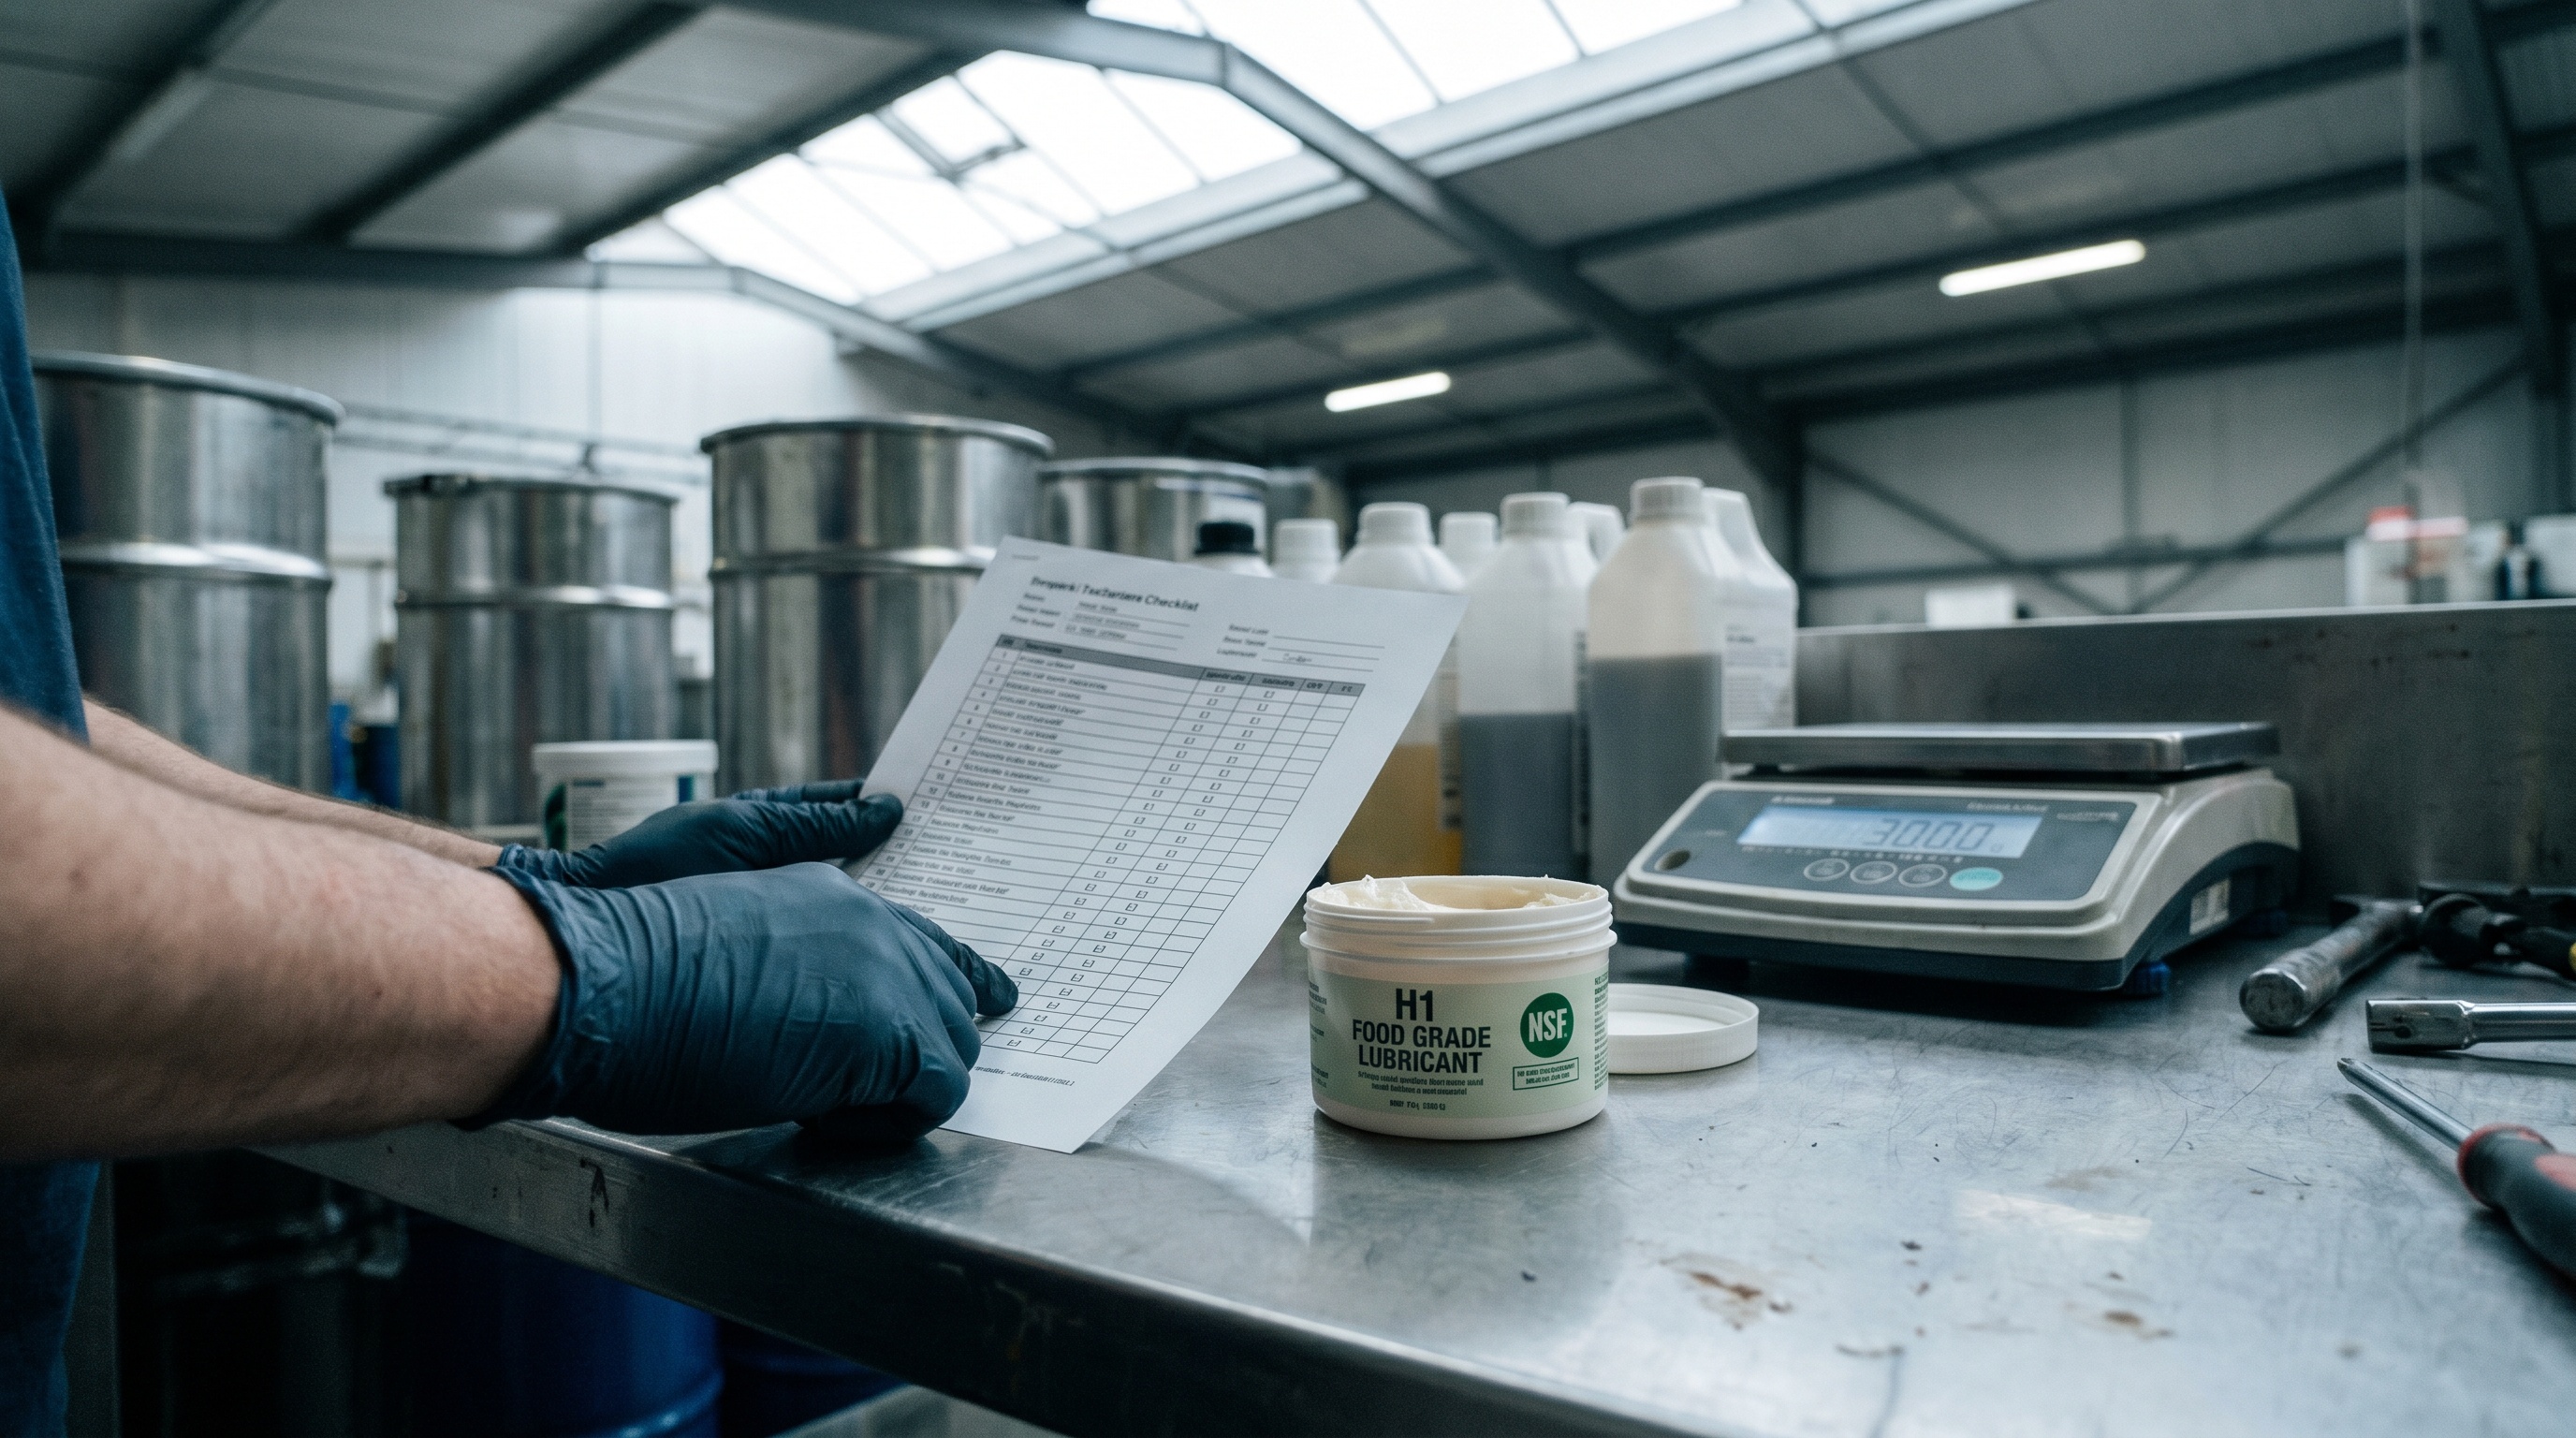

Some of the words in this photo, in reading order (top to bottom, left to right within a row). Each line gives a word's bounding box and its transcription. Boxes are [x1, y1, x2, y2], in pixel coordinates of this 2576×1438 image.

[1396, 988, 1433, 1021] H1
[1353, 1019, 1405, 1045] FOOD
[1412, 1025, 1491, 1049] GRADE
[1528, 1007, 1568, 1042] NSF
[1358, 1044, 1483, 1074] LUBRICANT
